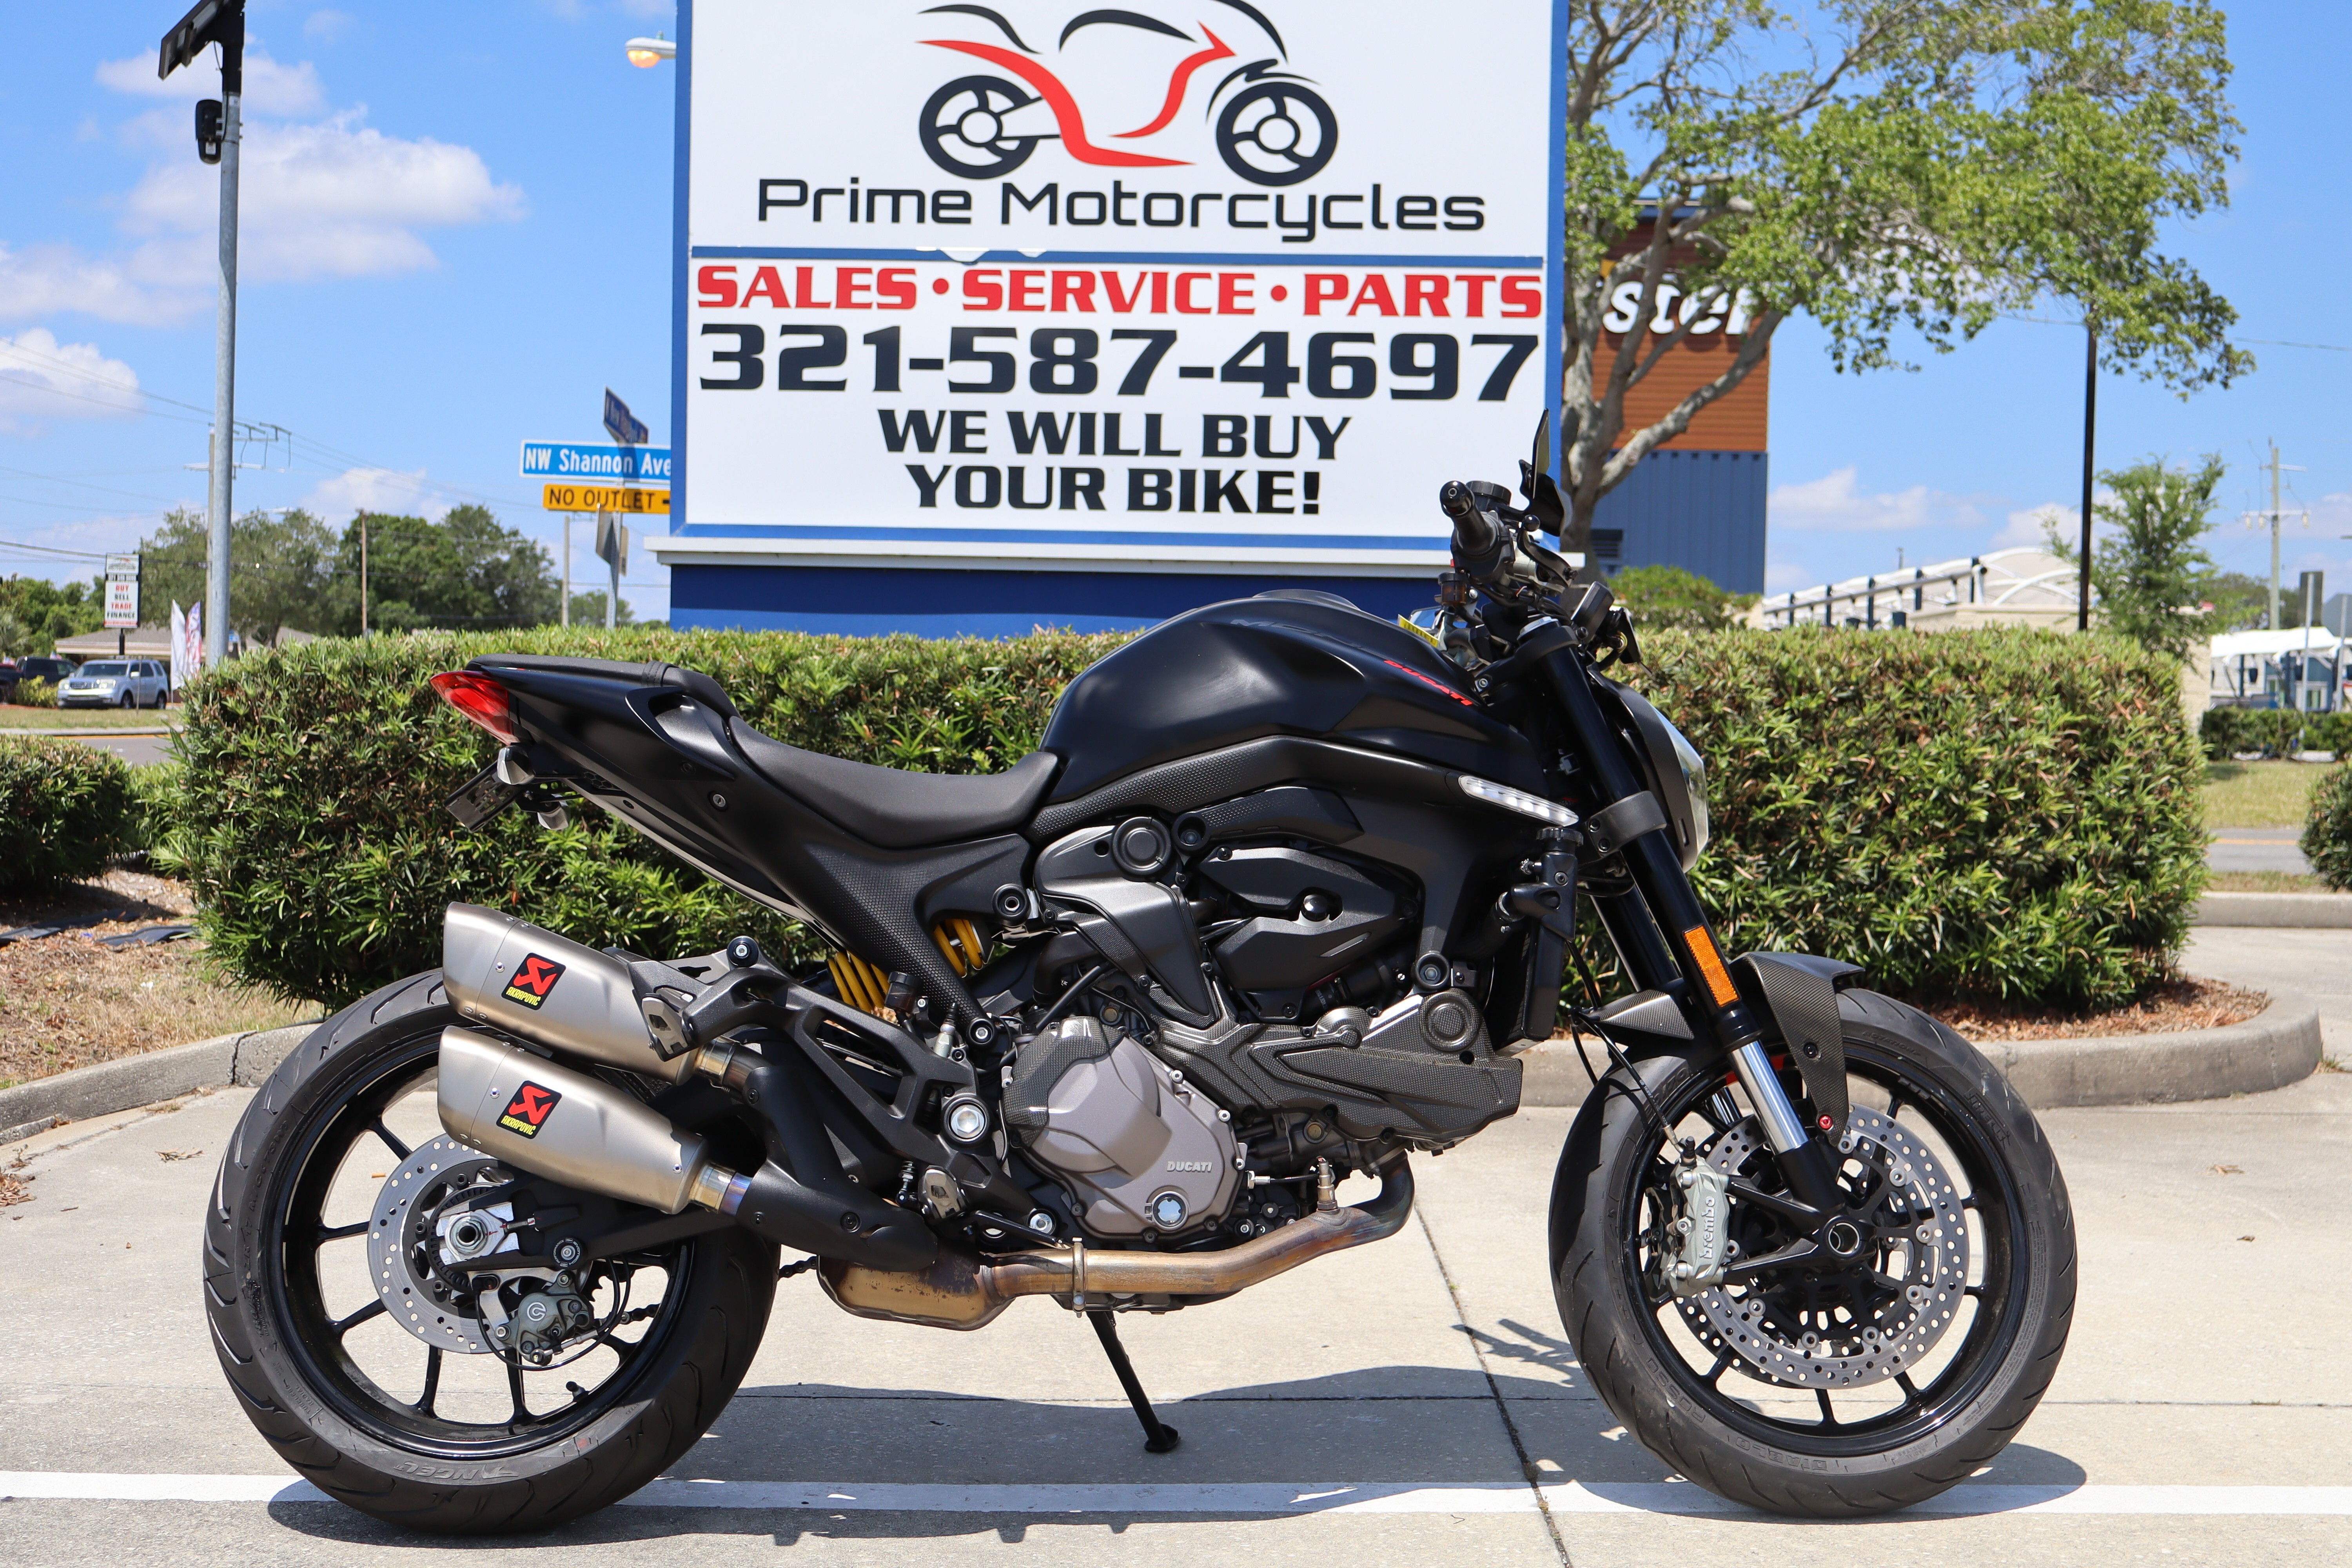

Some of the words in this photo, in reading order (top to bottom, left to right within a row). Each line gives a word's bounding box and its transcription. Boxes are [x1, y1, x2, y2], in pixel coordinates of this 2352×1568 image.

[758, 177, 972, 224] Prime
[1002, 182, 1485, 242] Motorcycles
[698, 265, 917, 310] SALES
[963, 269, 1255, 315] SERVICE
[1304, 274, 1542, 318] PARTS
[700, 323, 1539, 402] 321-587-4697
[877, 409, 987, 454] WE
[1006, 411, 1181, 457] WILL
[1202, 414, 1351, 460] BUY
[525, 448, 552, 470] NW
[559, 448, 633, 474] Shannon
[641, 452, 671, 476] Ave
[550, 488, 575, 505] NO
[584, 489, 655, 509] OUTLET
[905, 464, 1106, 510] YOUR
[1127, 468, 1320, 515] BIKE!
[1384, 659, 1474, 706] DUCATI
[1166, 1161, 1212, 1172] DUCATI
[1699, 1196, 1715, 1259] brembo
[1735, 1436, 1829, 1472] DIABLO
